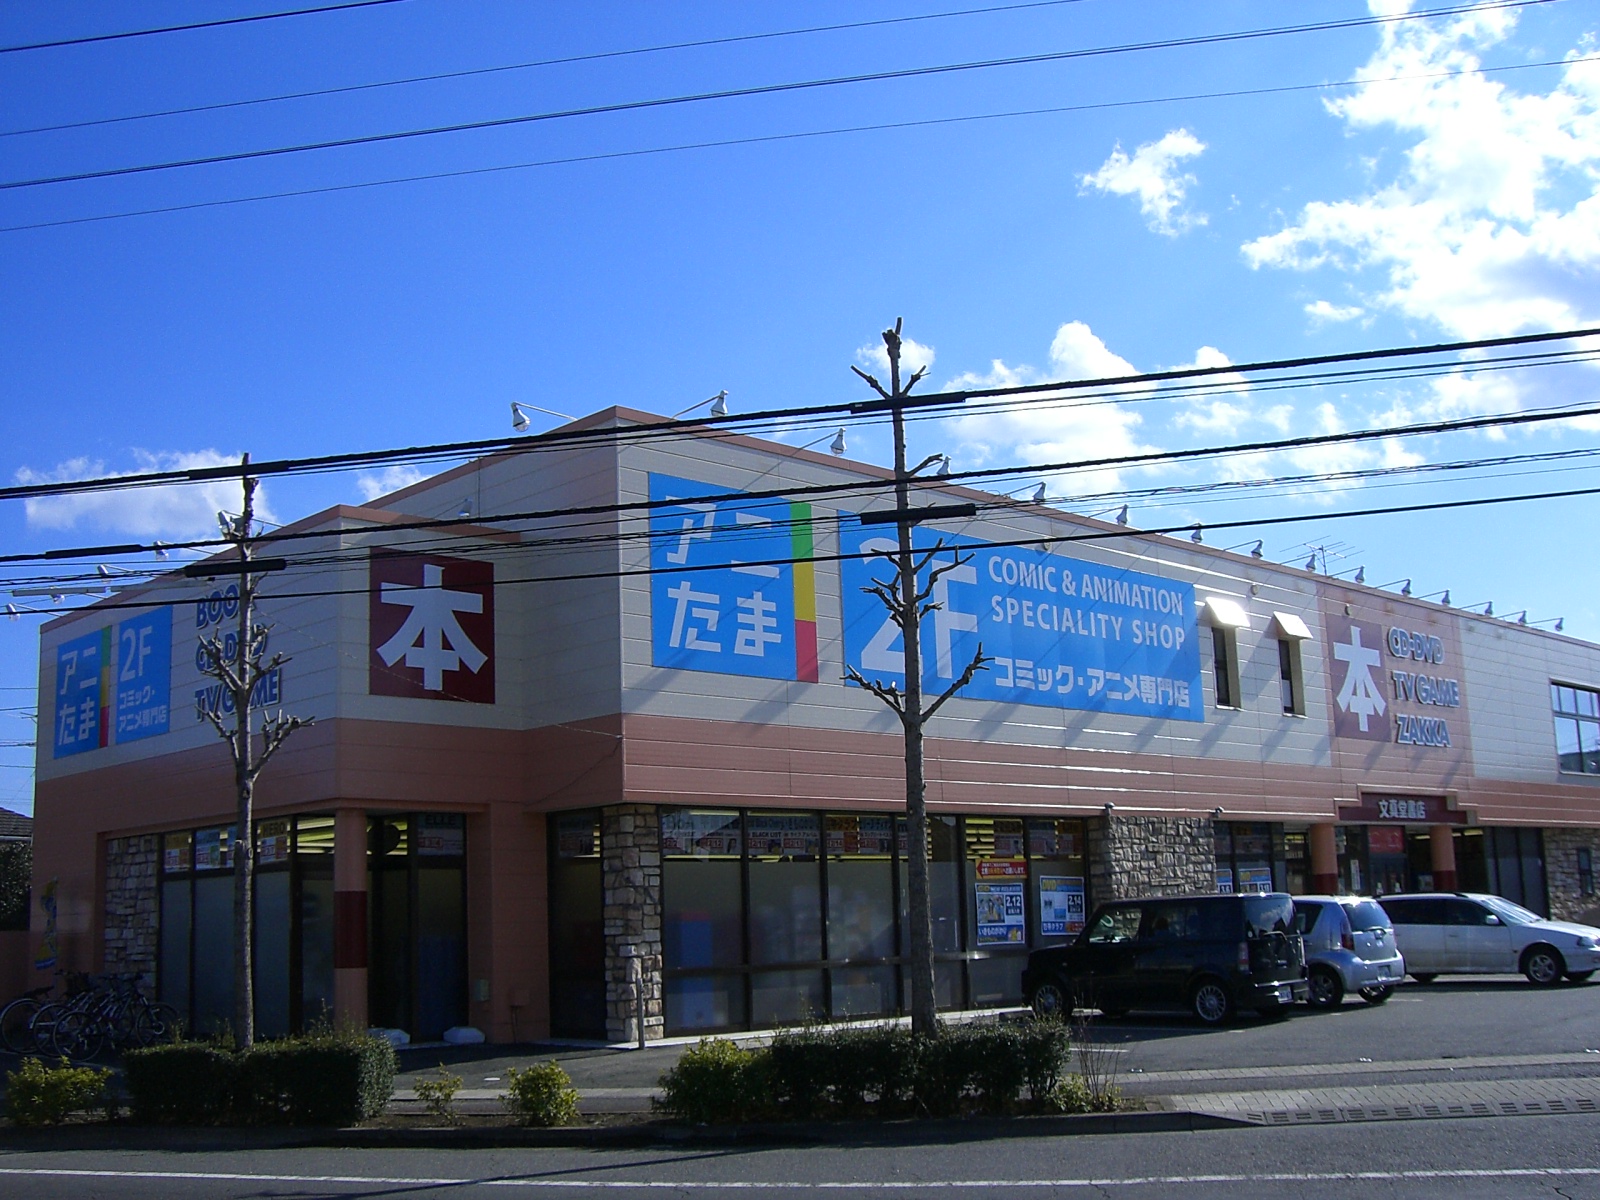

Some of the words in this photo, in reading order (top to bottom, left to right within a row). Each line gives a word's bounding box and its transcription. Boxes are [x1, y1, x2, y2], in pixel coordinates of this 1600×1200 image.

[665, 495, 780, 578] アニ
[196, 584, 256, 628] BOO
[988, 555, 1057, 593] COMIC
[1061, 569, 1077, 596] &
[1081, 573, 1184, 616] ANIMATION
[376, 564, 489, 691] 本
[667, 581, 782, 657] たま
[991, 595, 1123, 641] SPECIALITY
[1132, 619, 1185, 650] SHOP
[60, 646, 98, 695] アニ
[120, 626, 153, 682] 2F
[1333, 625, 1387, 732] 本
[221, 668, 281, 714] GME
[994, 656, 1191, 708] コミック・アニメ専門店
[1392, 670, 1415, 700] TV
[1416, 674, 1460, 707] GAME
[59, 696, 96, 746] たま
[1396, 714, 1451, 747] ZAKKA
[1006, 896, 1021, 906] 2.12
